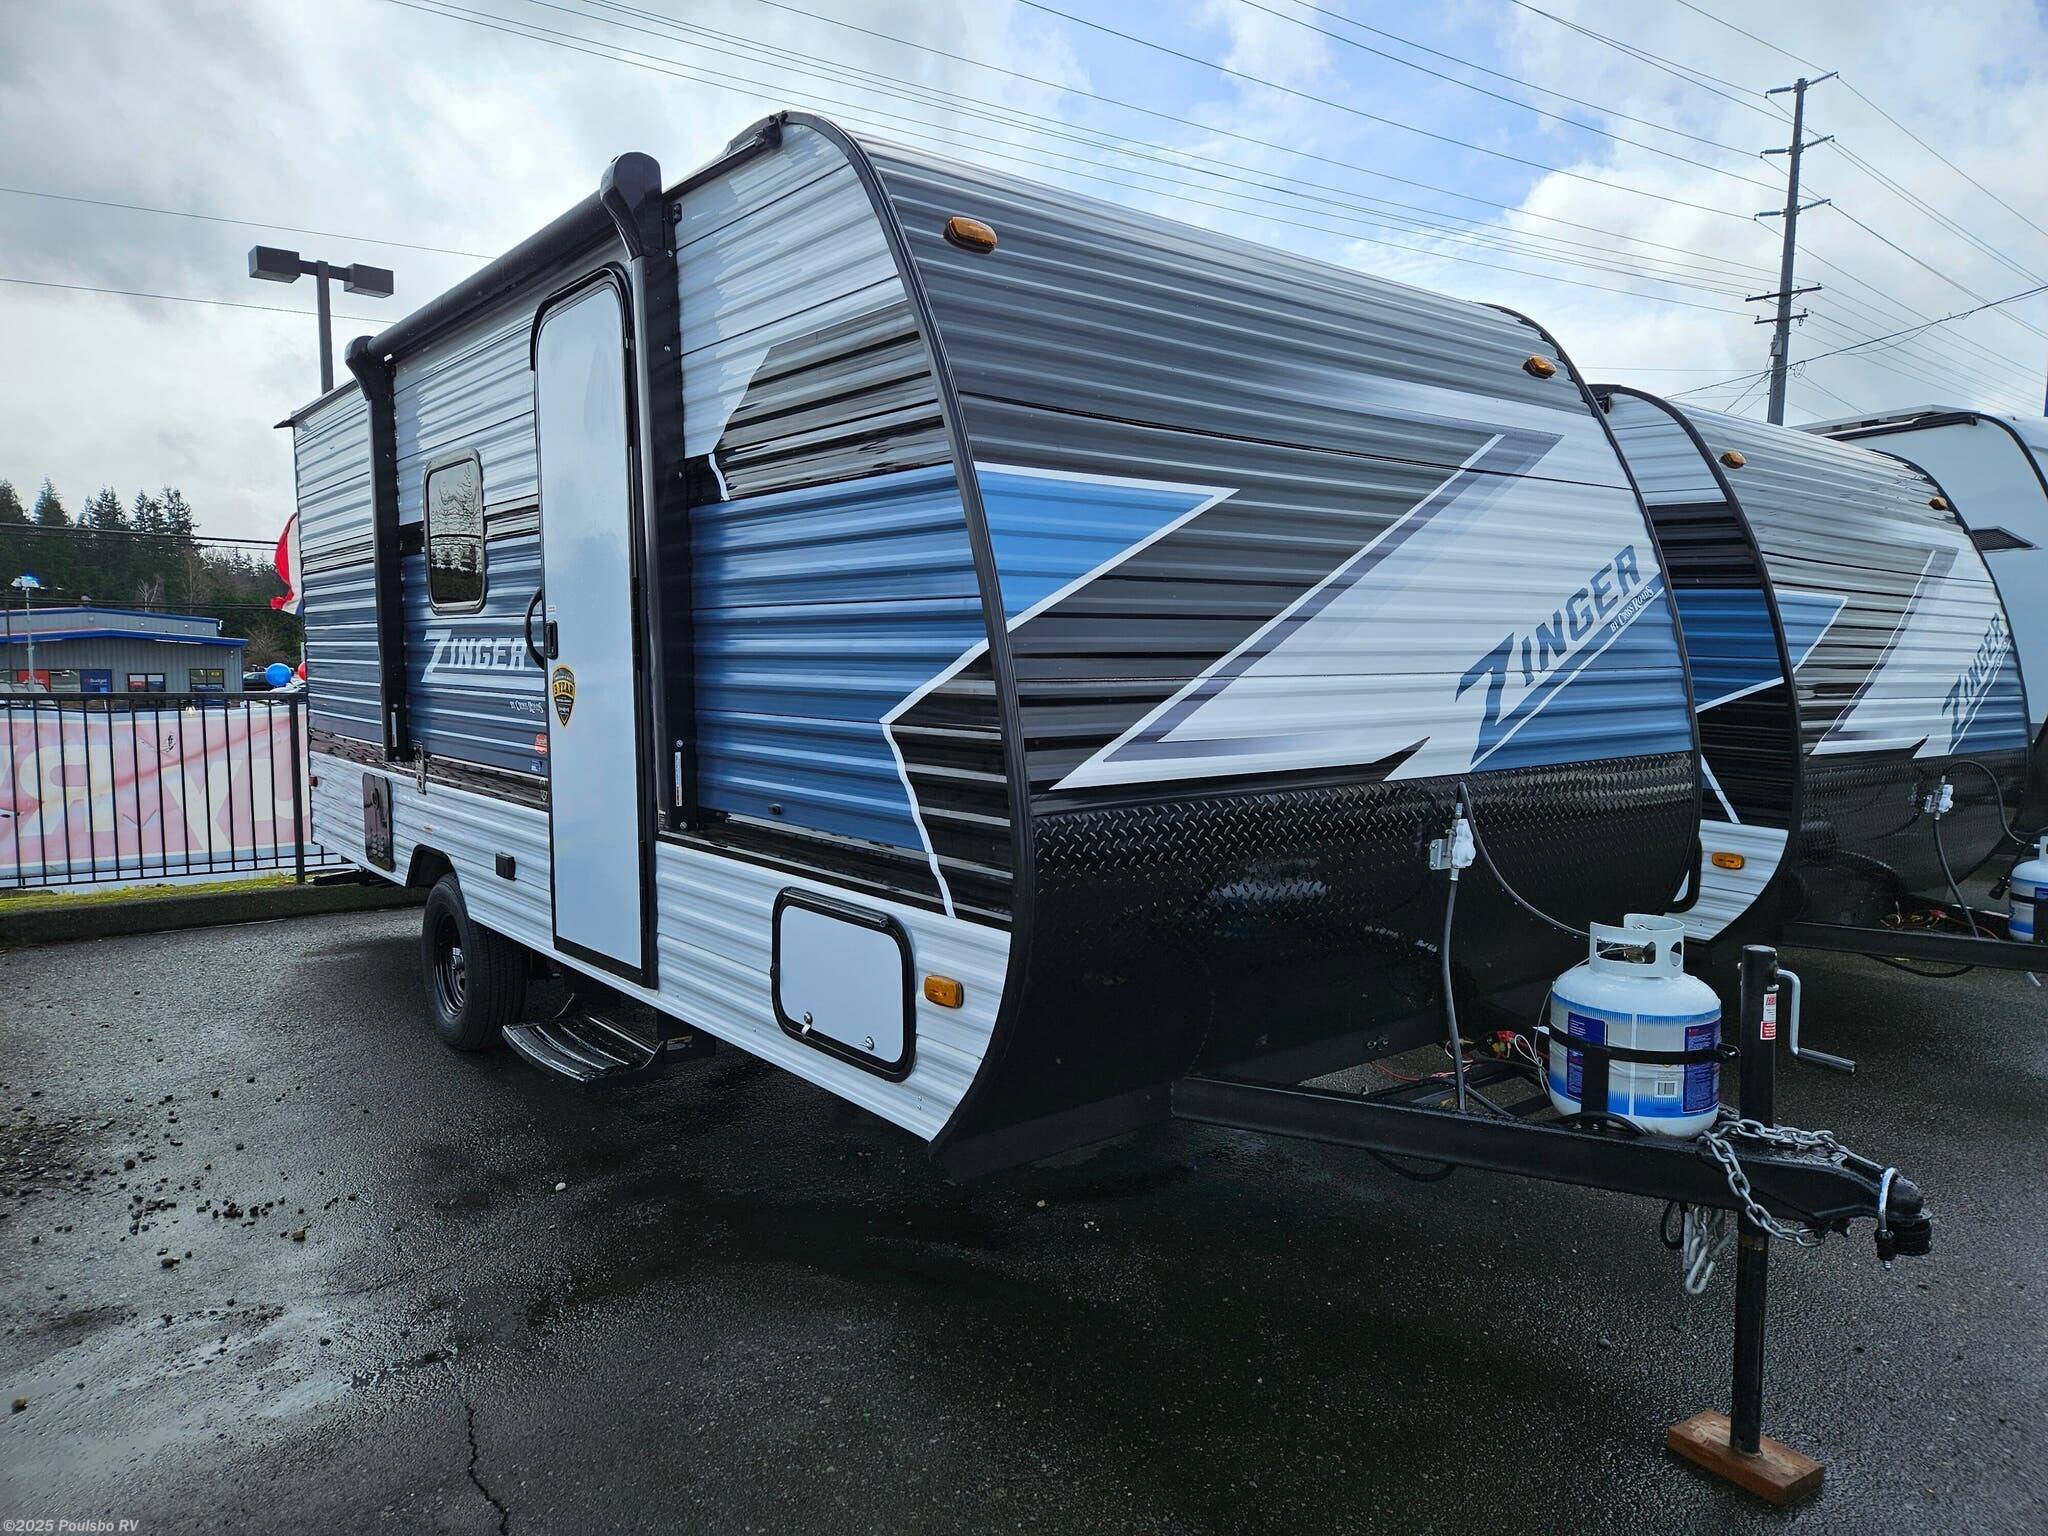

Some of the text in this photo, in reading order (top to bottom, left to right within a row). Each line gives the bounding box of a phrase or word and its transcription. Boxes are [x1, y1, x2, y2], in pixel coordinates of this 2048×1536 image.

[421, 628, 528, 683] ZINGER
[559, 681, 574, 695] YEAR
[1455, 544, 1641, 766] ZINGER
[1942, 612, 2004, 752] ZINGER
